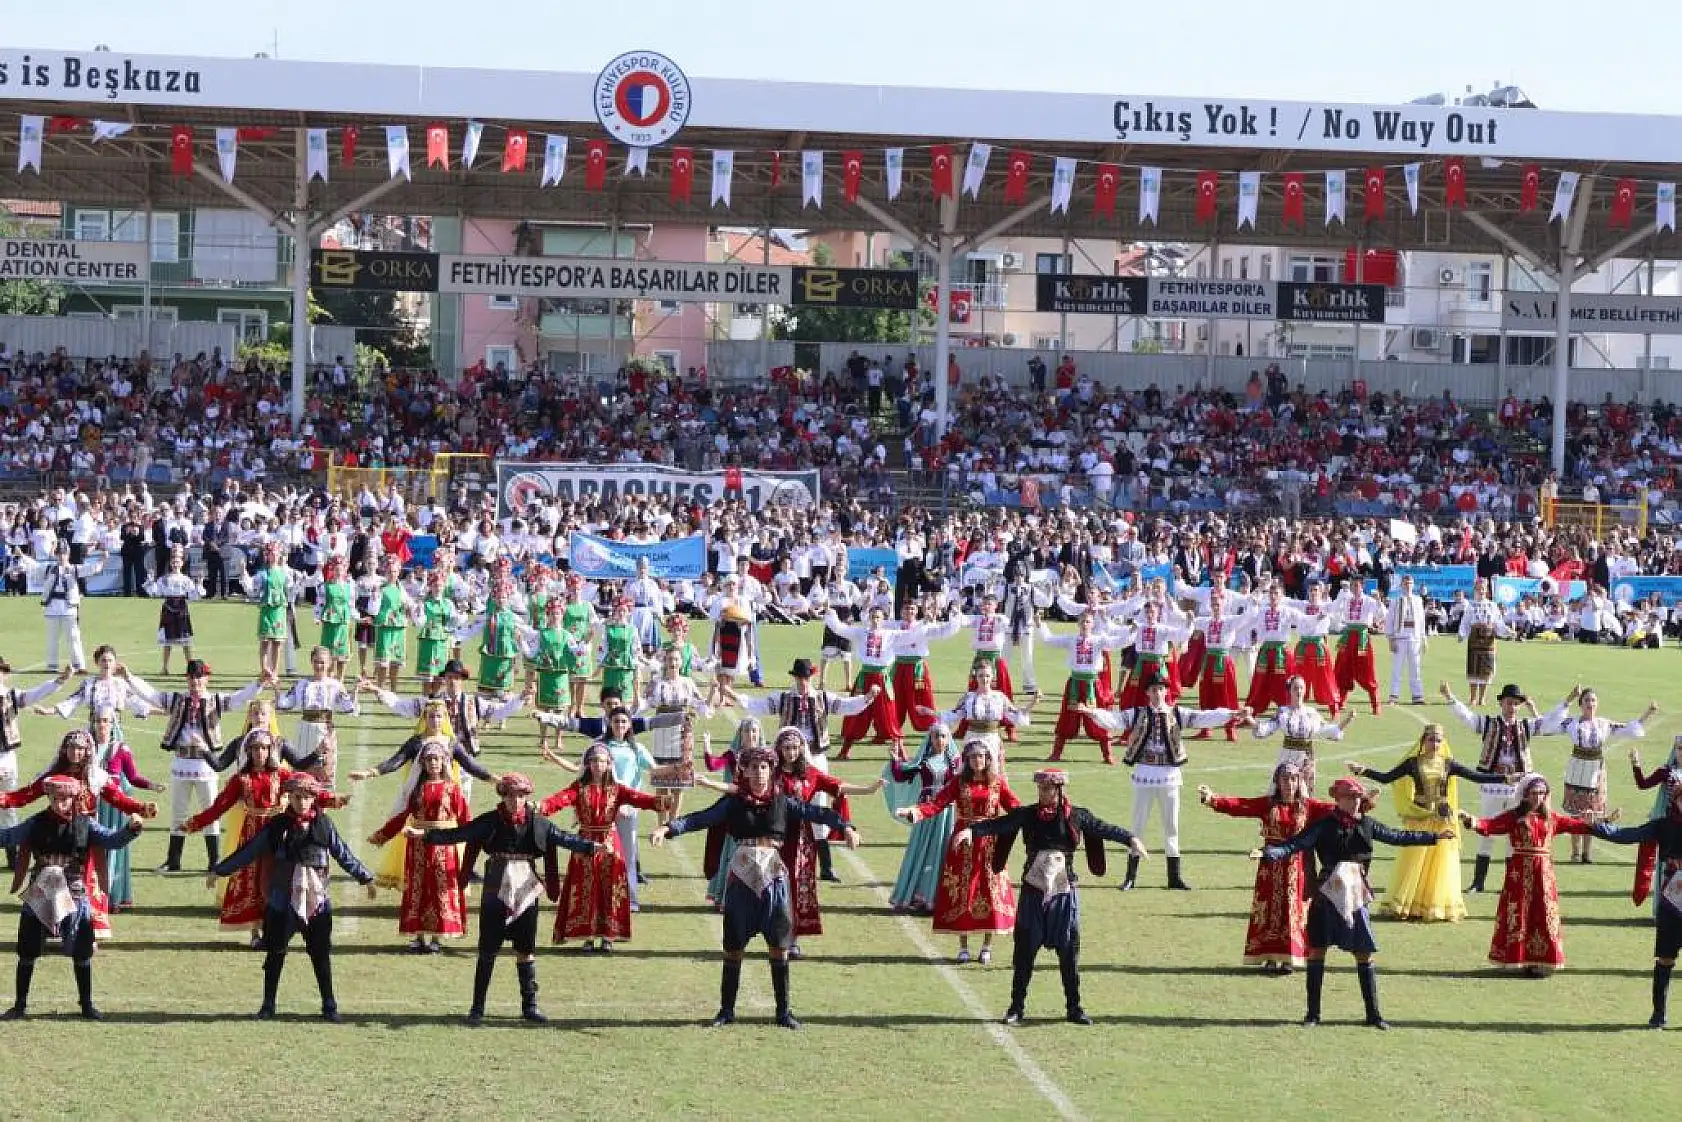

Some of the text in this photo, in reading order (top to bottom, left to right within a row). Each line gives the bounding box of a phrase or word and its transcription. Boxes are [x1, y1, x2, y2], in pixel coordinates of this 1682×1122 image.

[22, 55, 50, 87] is
[63, 57, 201, 98] Beşkaza
[1113, 100, 1498, 147] Çıkış Yok ! / No Way Out
[6, 241, 81, 258] DENTAL
[64, 261, 137, 278] CENTER
[370, 260, 432, 279] ORKA
[452, 258, 780, 296] FETHİYESPOR'A BAŞARILAR DİLER
[851, 276, 912, 297] ORKA
[1159, 280, 1266, 297] FETHİYESPOR'A
[1153, 300, 1271, 315] BAŞARILAR DİLER
[1641, 307, 1682, 323] FETHİ
